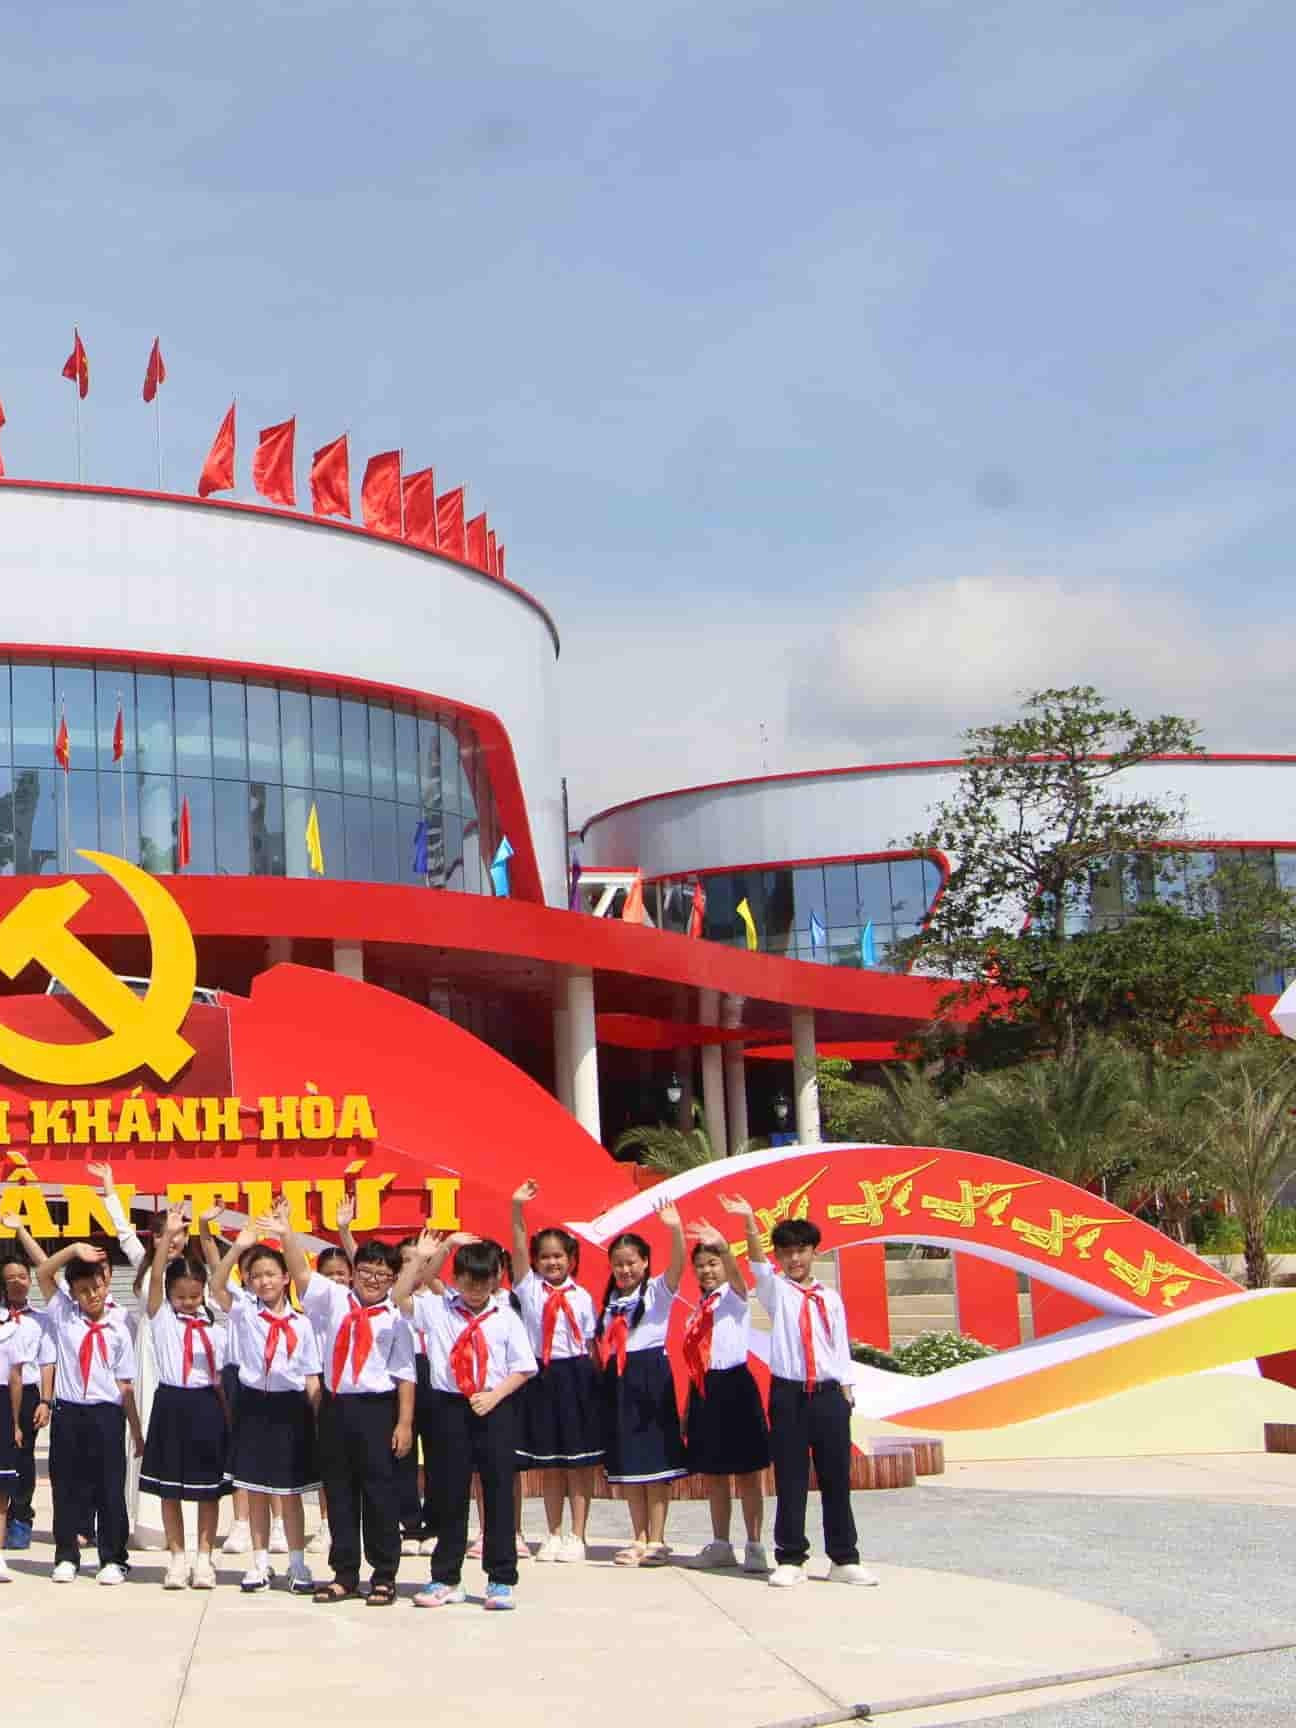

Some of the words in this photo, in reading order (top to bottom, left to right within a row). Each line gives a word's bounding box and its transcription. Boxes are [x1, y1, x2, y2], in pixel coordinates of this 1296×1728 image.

[30, 1084, 243, 1144] KHÁNH
[258, 1080, 378, 1140] HÒA
[166, 1160, 398, 1236] THỨ
[425, 1178, 461, 1231] I
